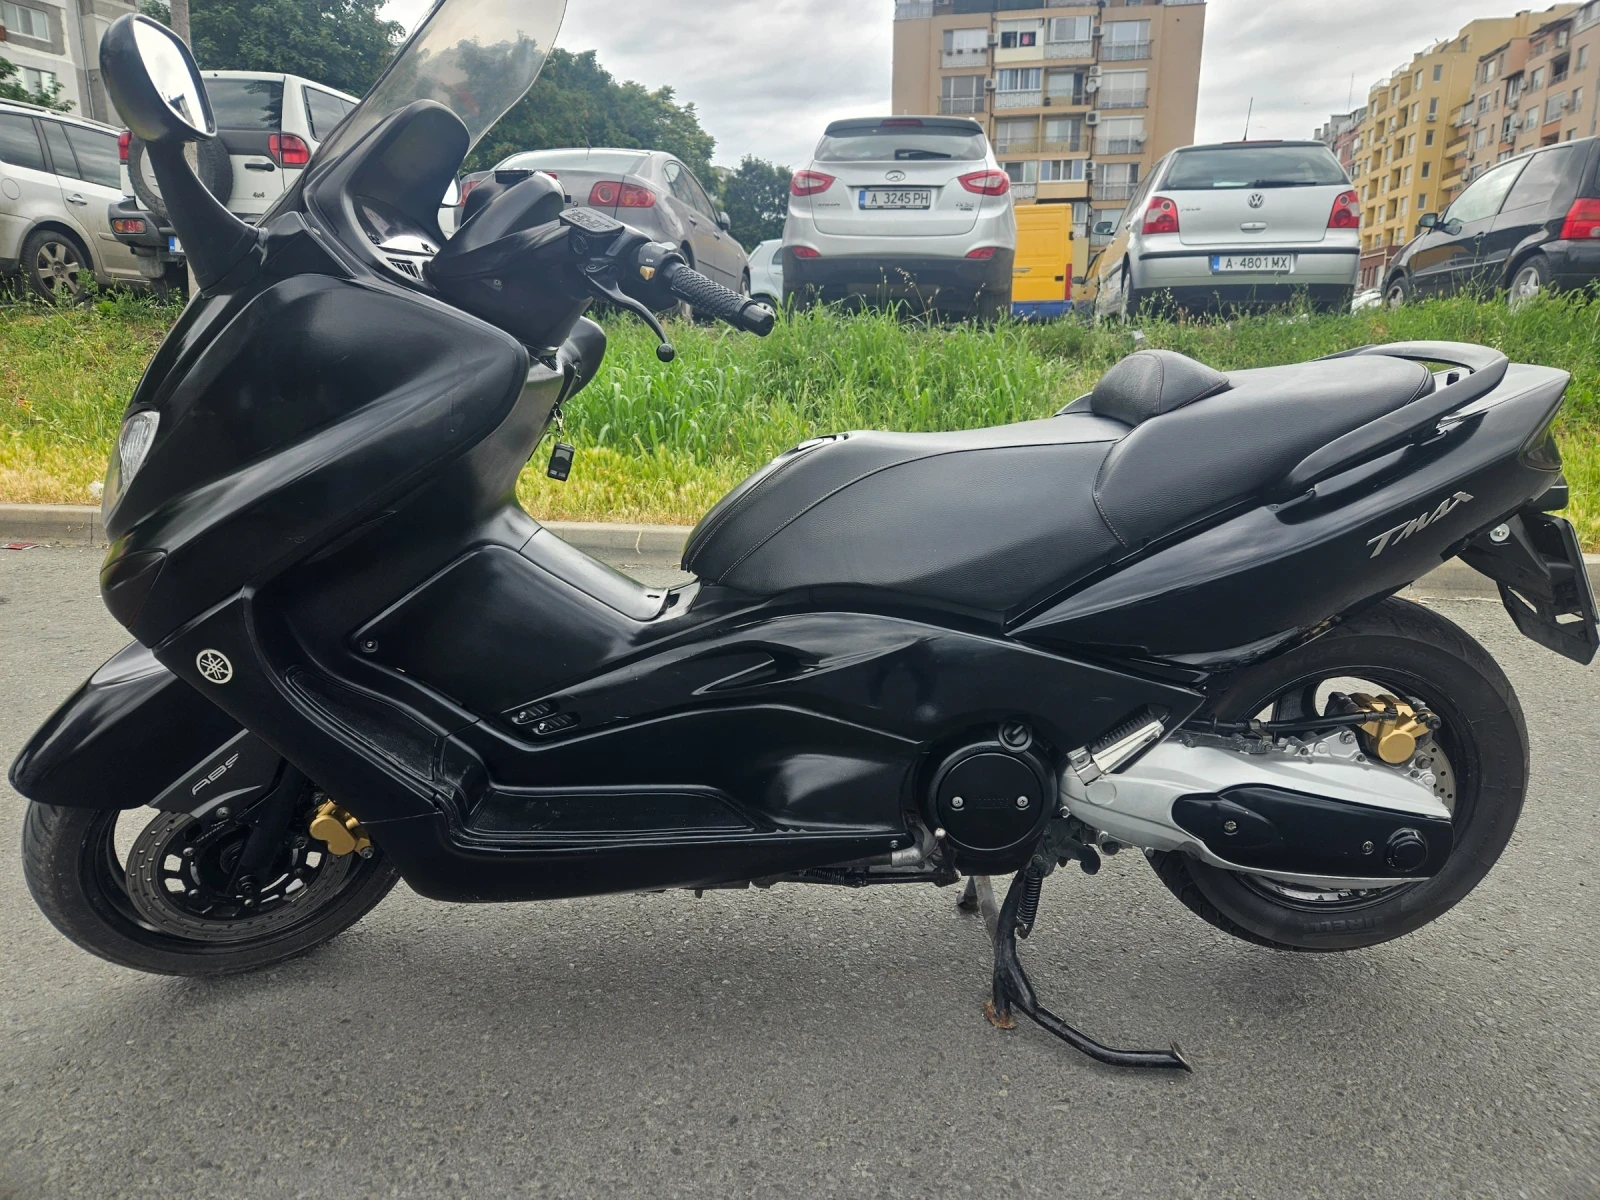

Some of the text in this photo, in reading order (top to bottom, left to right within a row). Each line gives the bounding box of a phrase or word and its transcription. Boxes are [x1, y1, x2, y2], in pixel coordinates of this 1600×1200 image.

[871, 192, 929, 205] A 3245 PH
[1225, 256, 1288, 269] A 4801 MX
[191, 753, 239, 796] ABS
